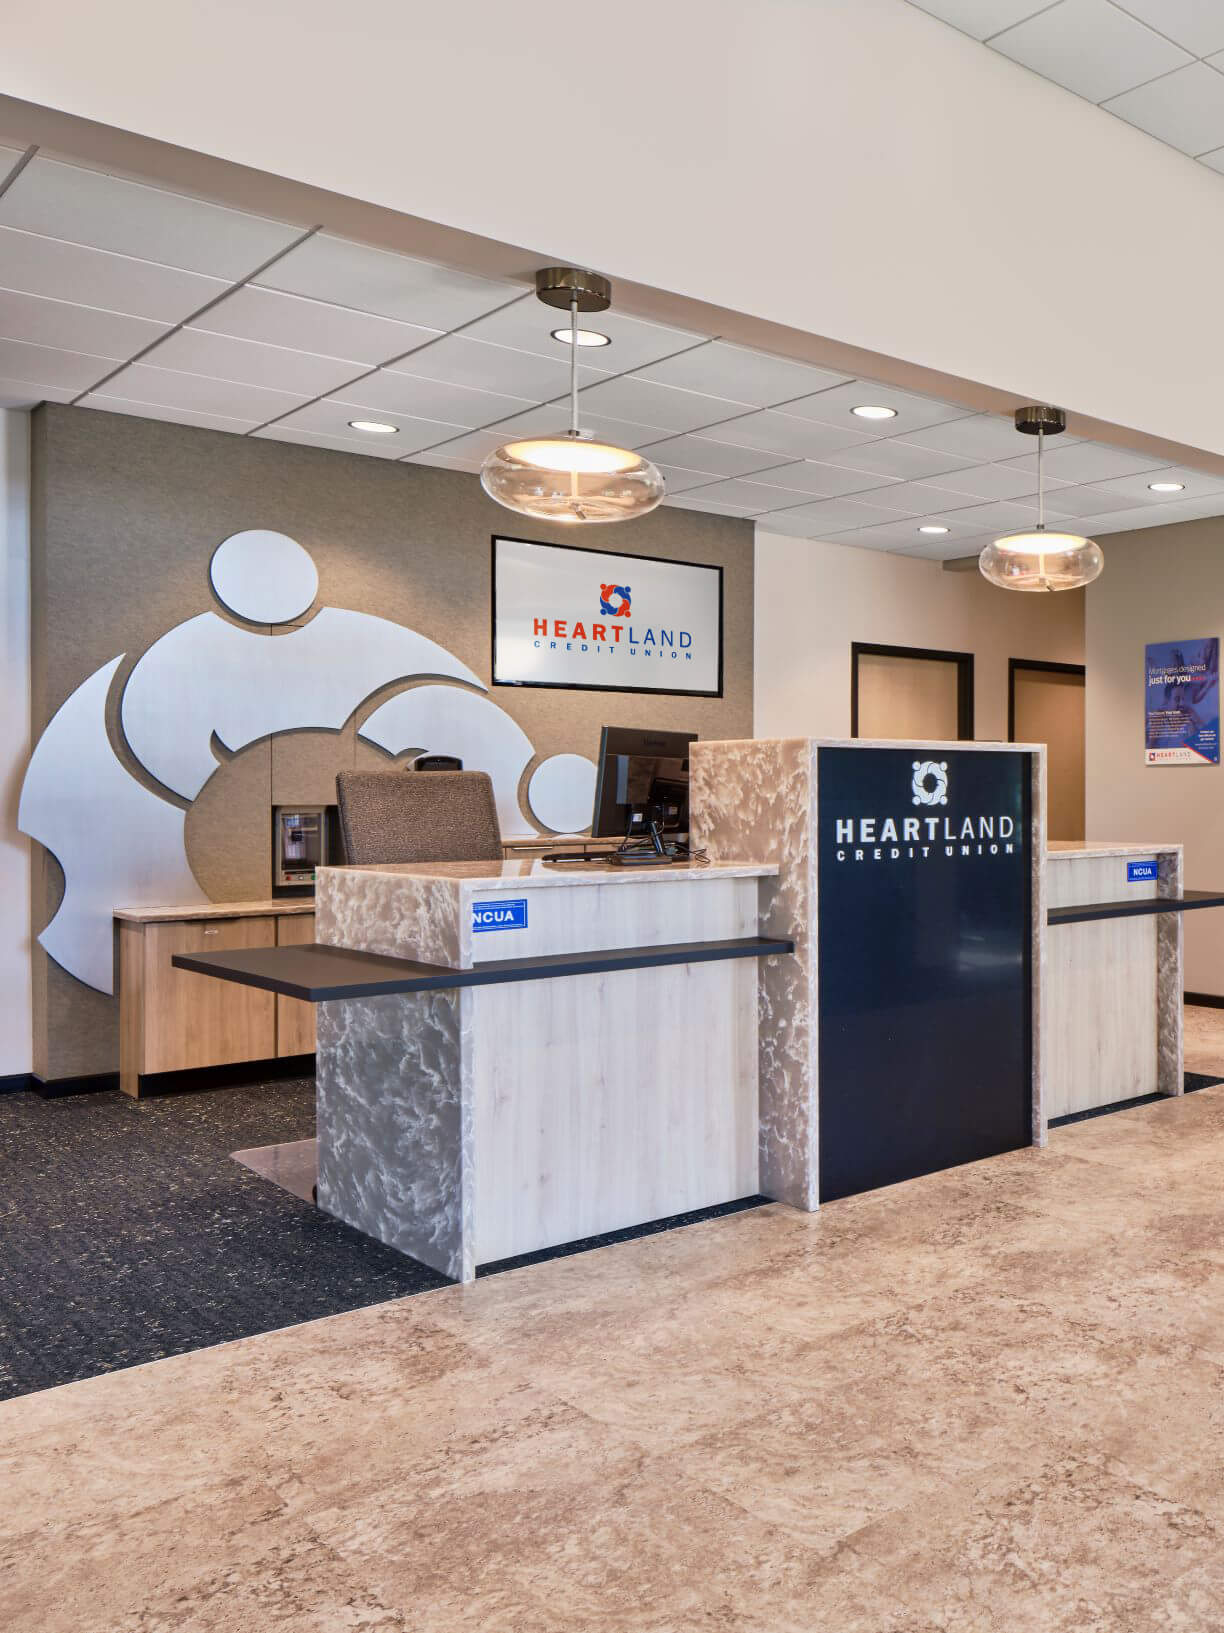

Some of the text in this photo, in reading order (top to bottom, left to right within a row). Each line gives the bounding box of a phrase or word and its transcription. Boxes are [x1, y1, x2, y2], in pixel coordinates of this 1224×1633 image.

[533, 618, 692, 648] HEARTLAND
[534, 640, 692, 660] CREDIT UNION
[1178, 663, 1206, 673] designed
[1148, 674, 1163, 687] just
[1164, 674, 1176, 684] for
[835, 815, 1014, 844] HEARTLAND
[836, 843, 1014, 862] CREDIT UNION
[1133, 867, 1152, 876] NCUA
[472, 910, 514, 924] NCUA
